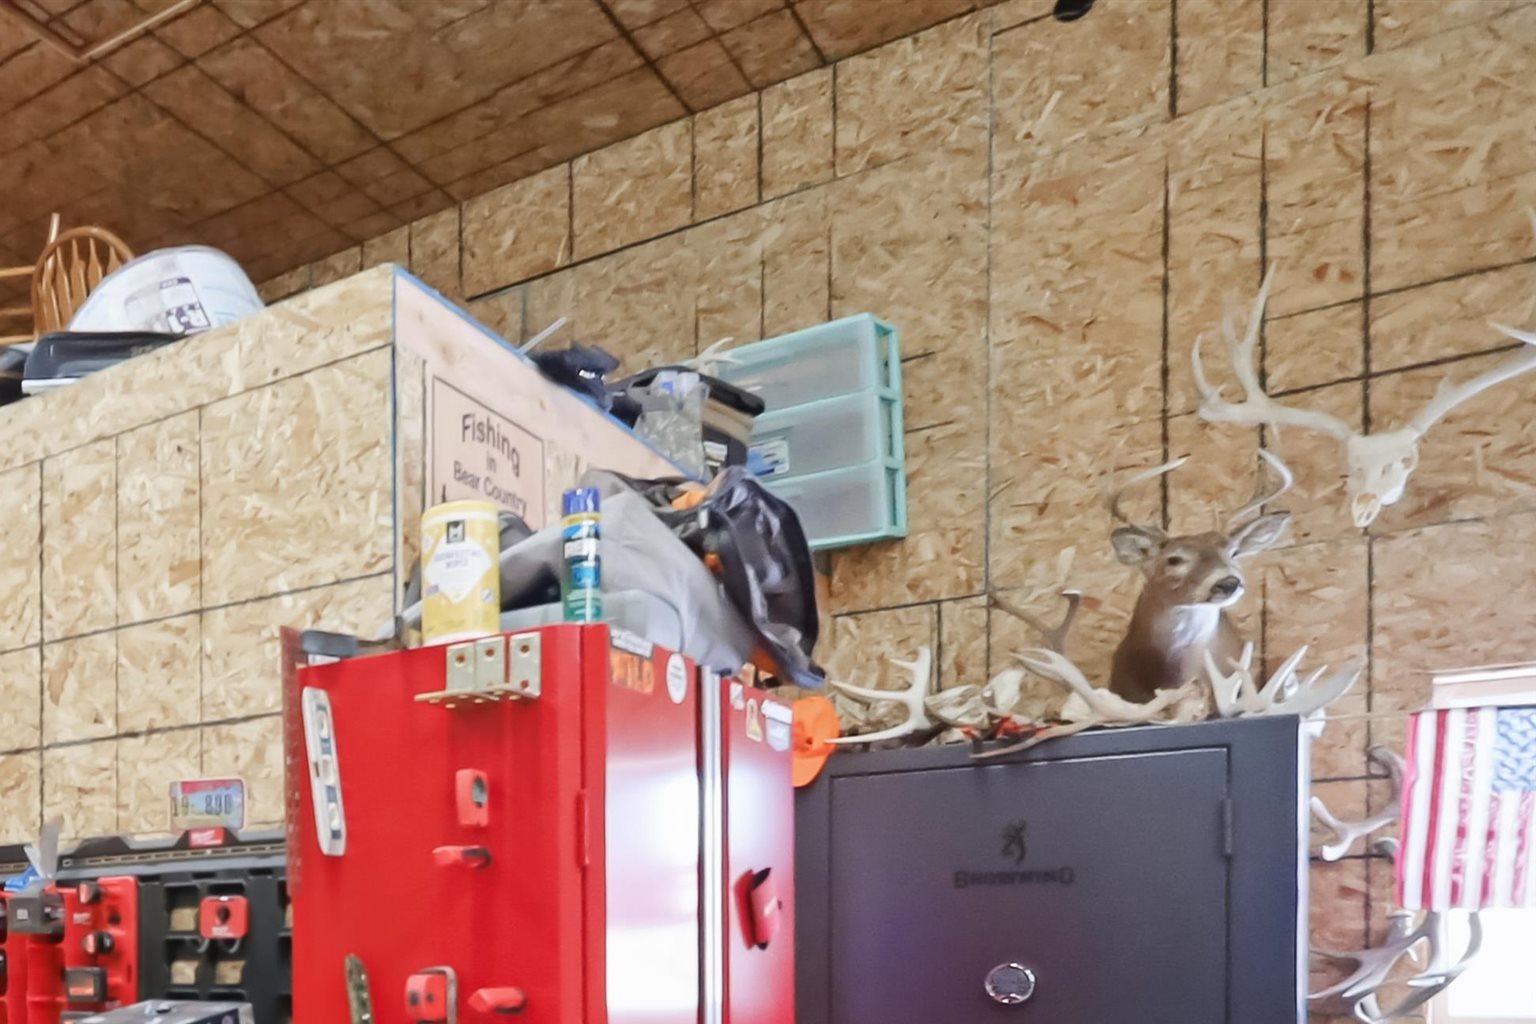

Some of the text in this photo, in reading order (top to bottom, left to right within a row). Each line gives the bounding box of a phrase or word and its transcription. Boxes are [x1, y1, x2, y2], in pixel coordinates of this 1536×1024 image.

[462, 413, 520, 478] Fishing
[486, 450, 497, 473] in
[454, 460, 527, 520] Bear Country
